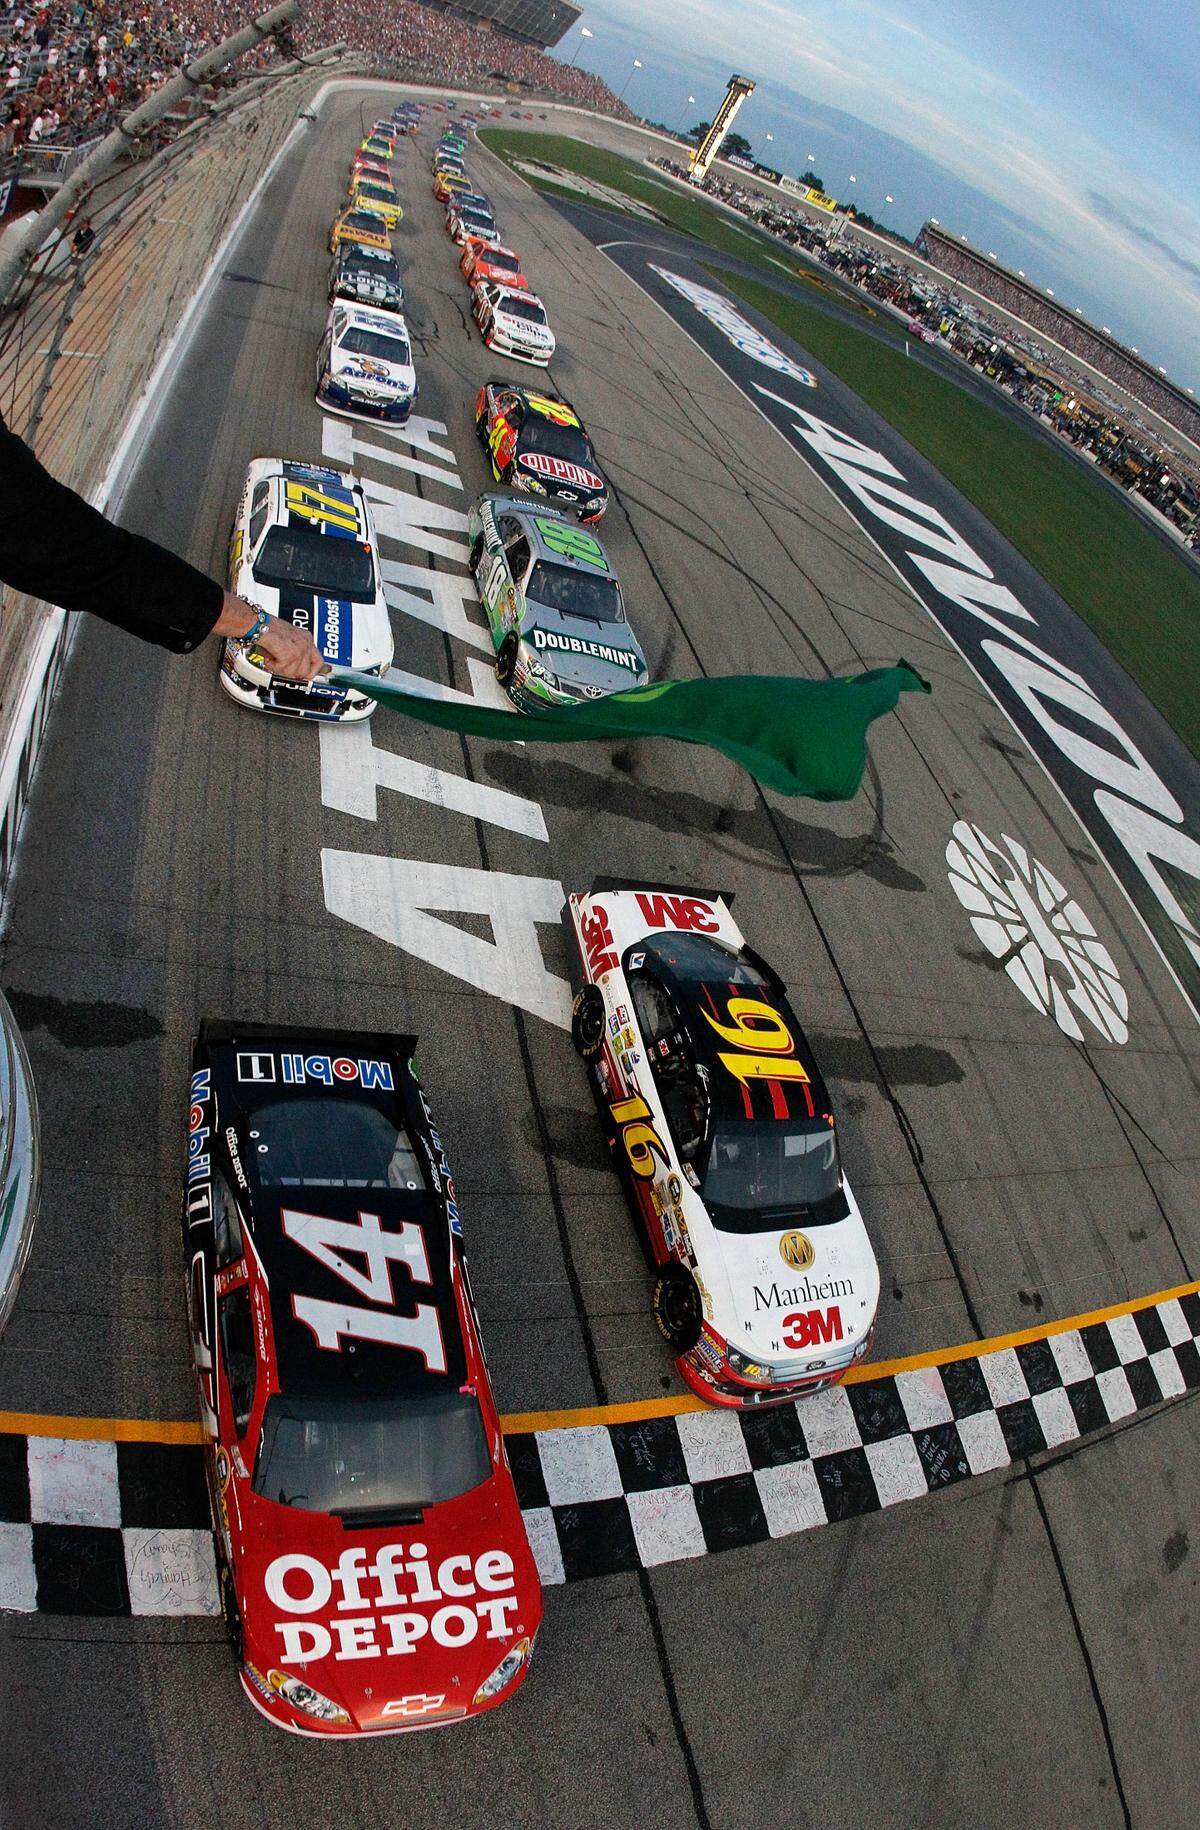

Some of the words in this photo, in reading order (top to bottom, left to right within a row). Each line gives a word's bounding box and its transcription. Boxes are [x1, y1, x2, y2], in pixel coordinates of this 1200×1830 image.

[342, 366, 410, 392] Aaron's
[285, 480, 361, 535] 17
[480, 500, 503, 552] DOUBLEMINT
[534, 517, 610, 573] 18
[484, 555, 508, 612] 18
[323, 597, 340, 660] EcoBoost
[533, 628, 639, 673] DOUBLEMINT
[532, 662, 544, 675] 18
[635, 892, 720, 934] 3M
[581, 903, 620, 983] 3M
[700, 996, 811, 1089] 16
[281, 1053, 395, 1091] Mobil
[188, 1067, 211, 1184] Mobil
[610, 1080, 672, 1182] 16
[225, 1126, 239, 1158] Office
[233, 1157, 247, 1189] DEPOT
[675, 1236, 686, 1260] 3M
[281, 1207, 448, 1374] 14
[752, 1273, 854, 1313] Manheim
[698, 1340, 725, 1370] MAHLE
[782, 1305, 844, 1351] 3M
[264, 1542, 515, 1615] Office
[274, 1596, 519, 1665] DEPOT
